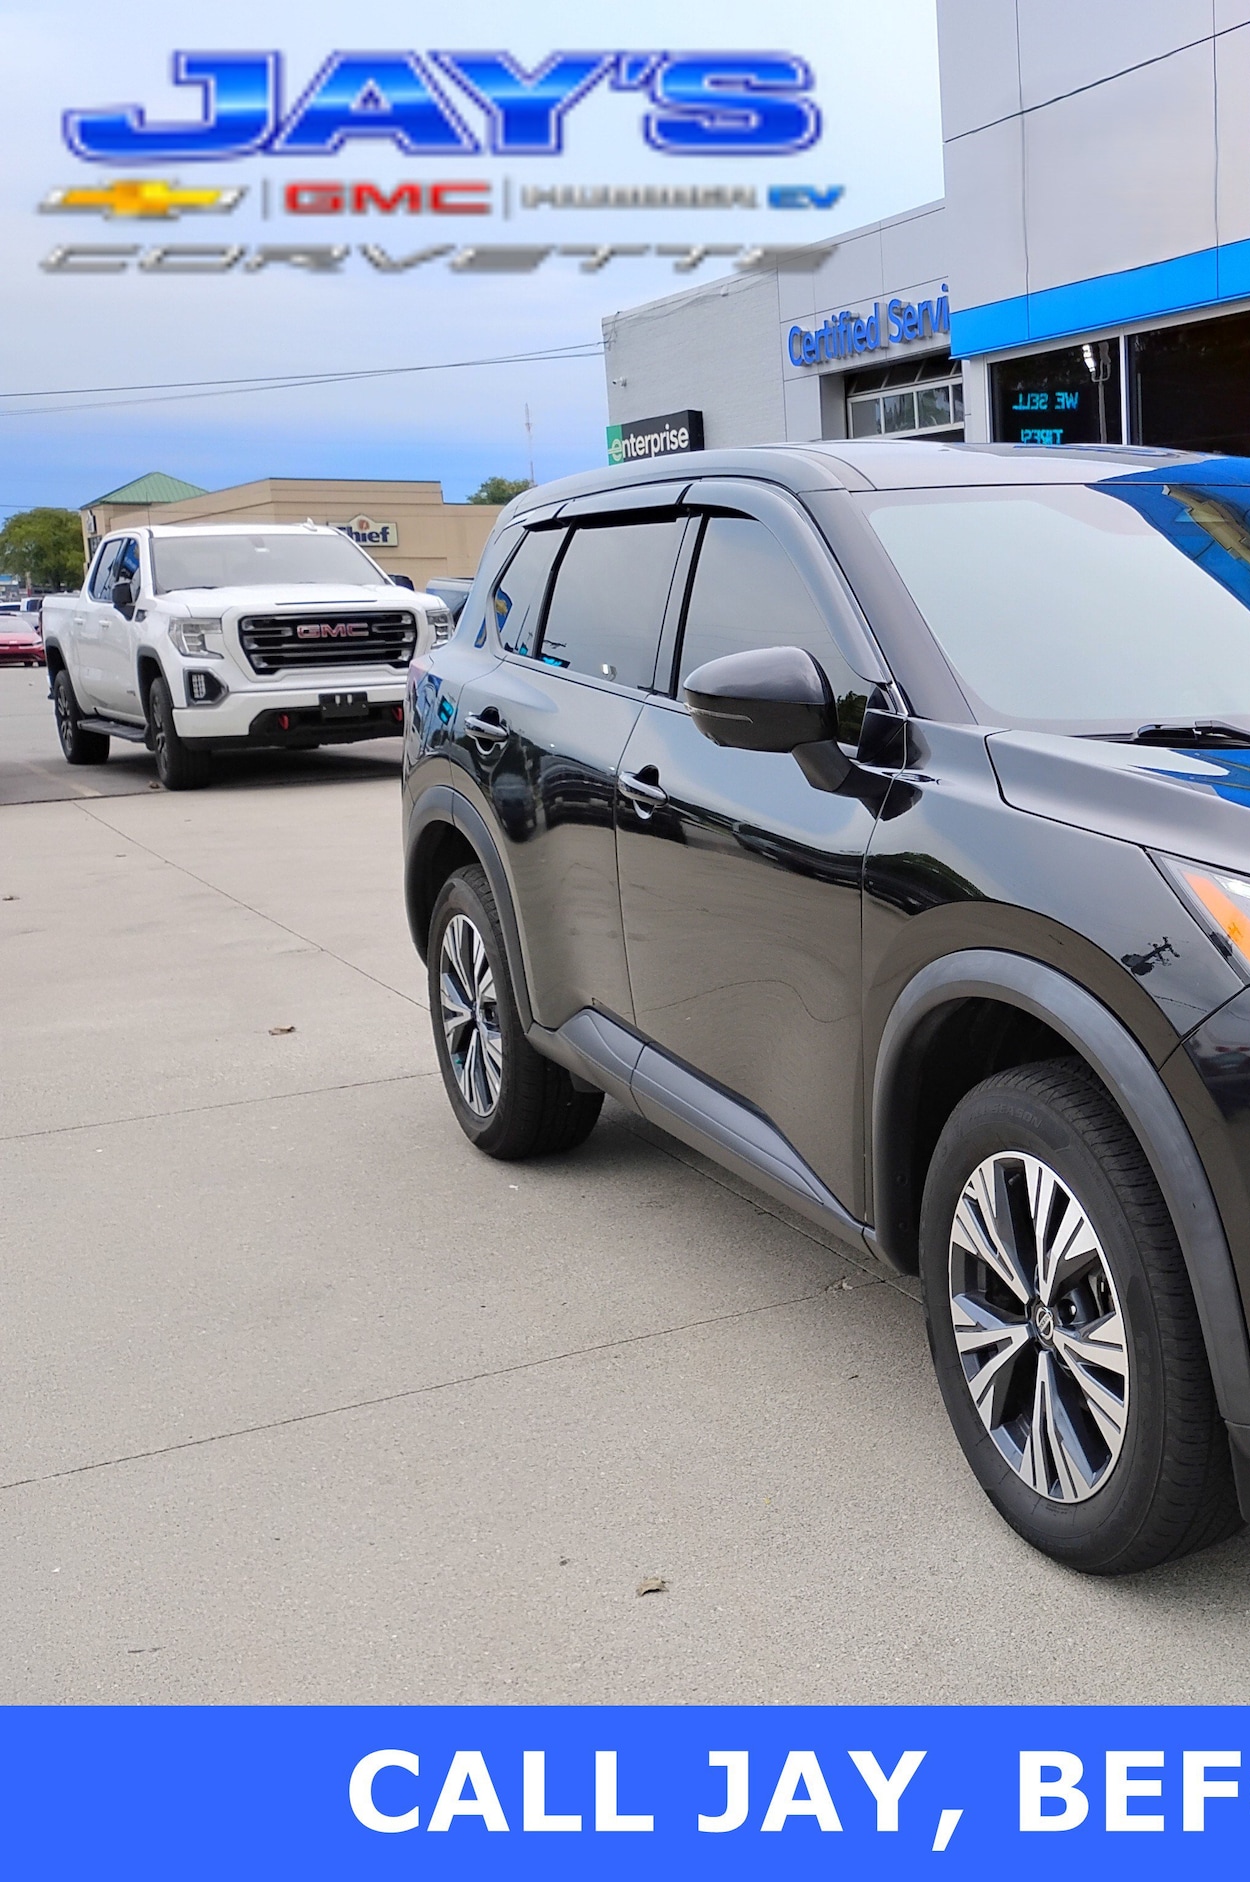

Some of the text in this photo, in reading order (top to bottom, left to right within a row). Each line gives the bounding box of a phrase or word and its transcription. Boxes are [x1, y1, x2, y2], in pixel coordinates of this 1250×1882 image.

[788, 302, 880, 368] Certified
[608, 423, 690, 462] enterprise
[336, 526, 390, 543] hief
[297, 622, 369, 639] GMC
[990, 1103, 1043, 1129] SEASON
